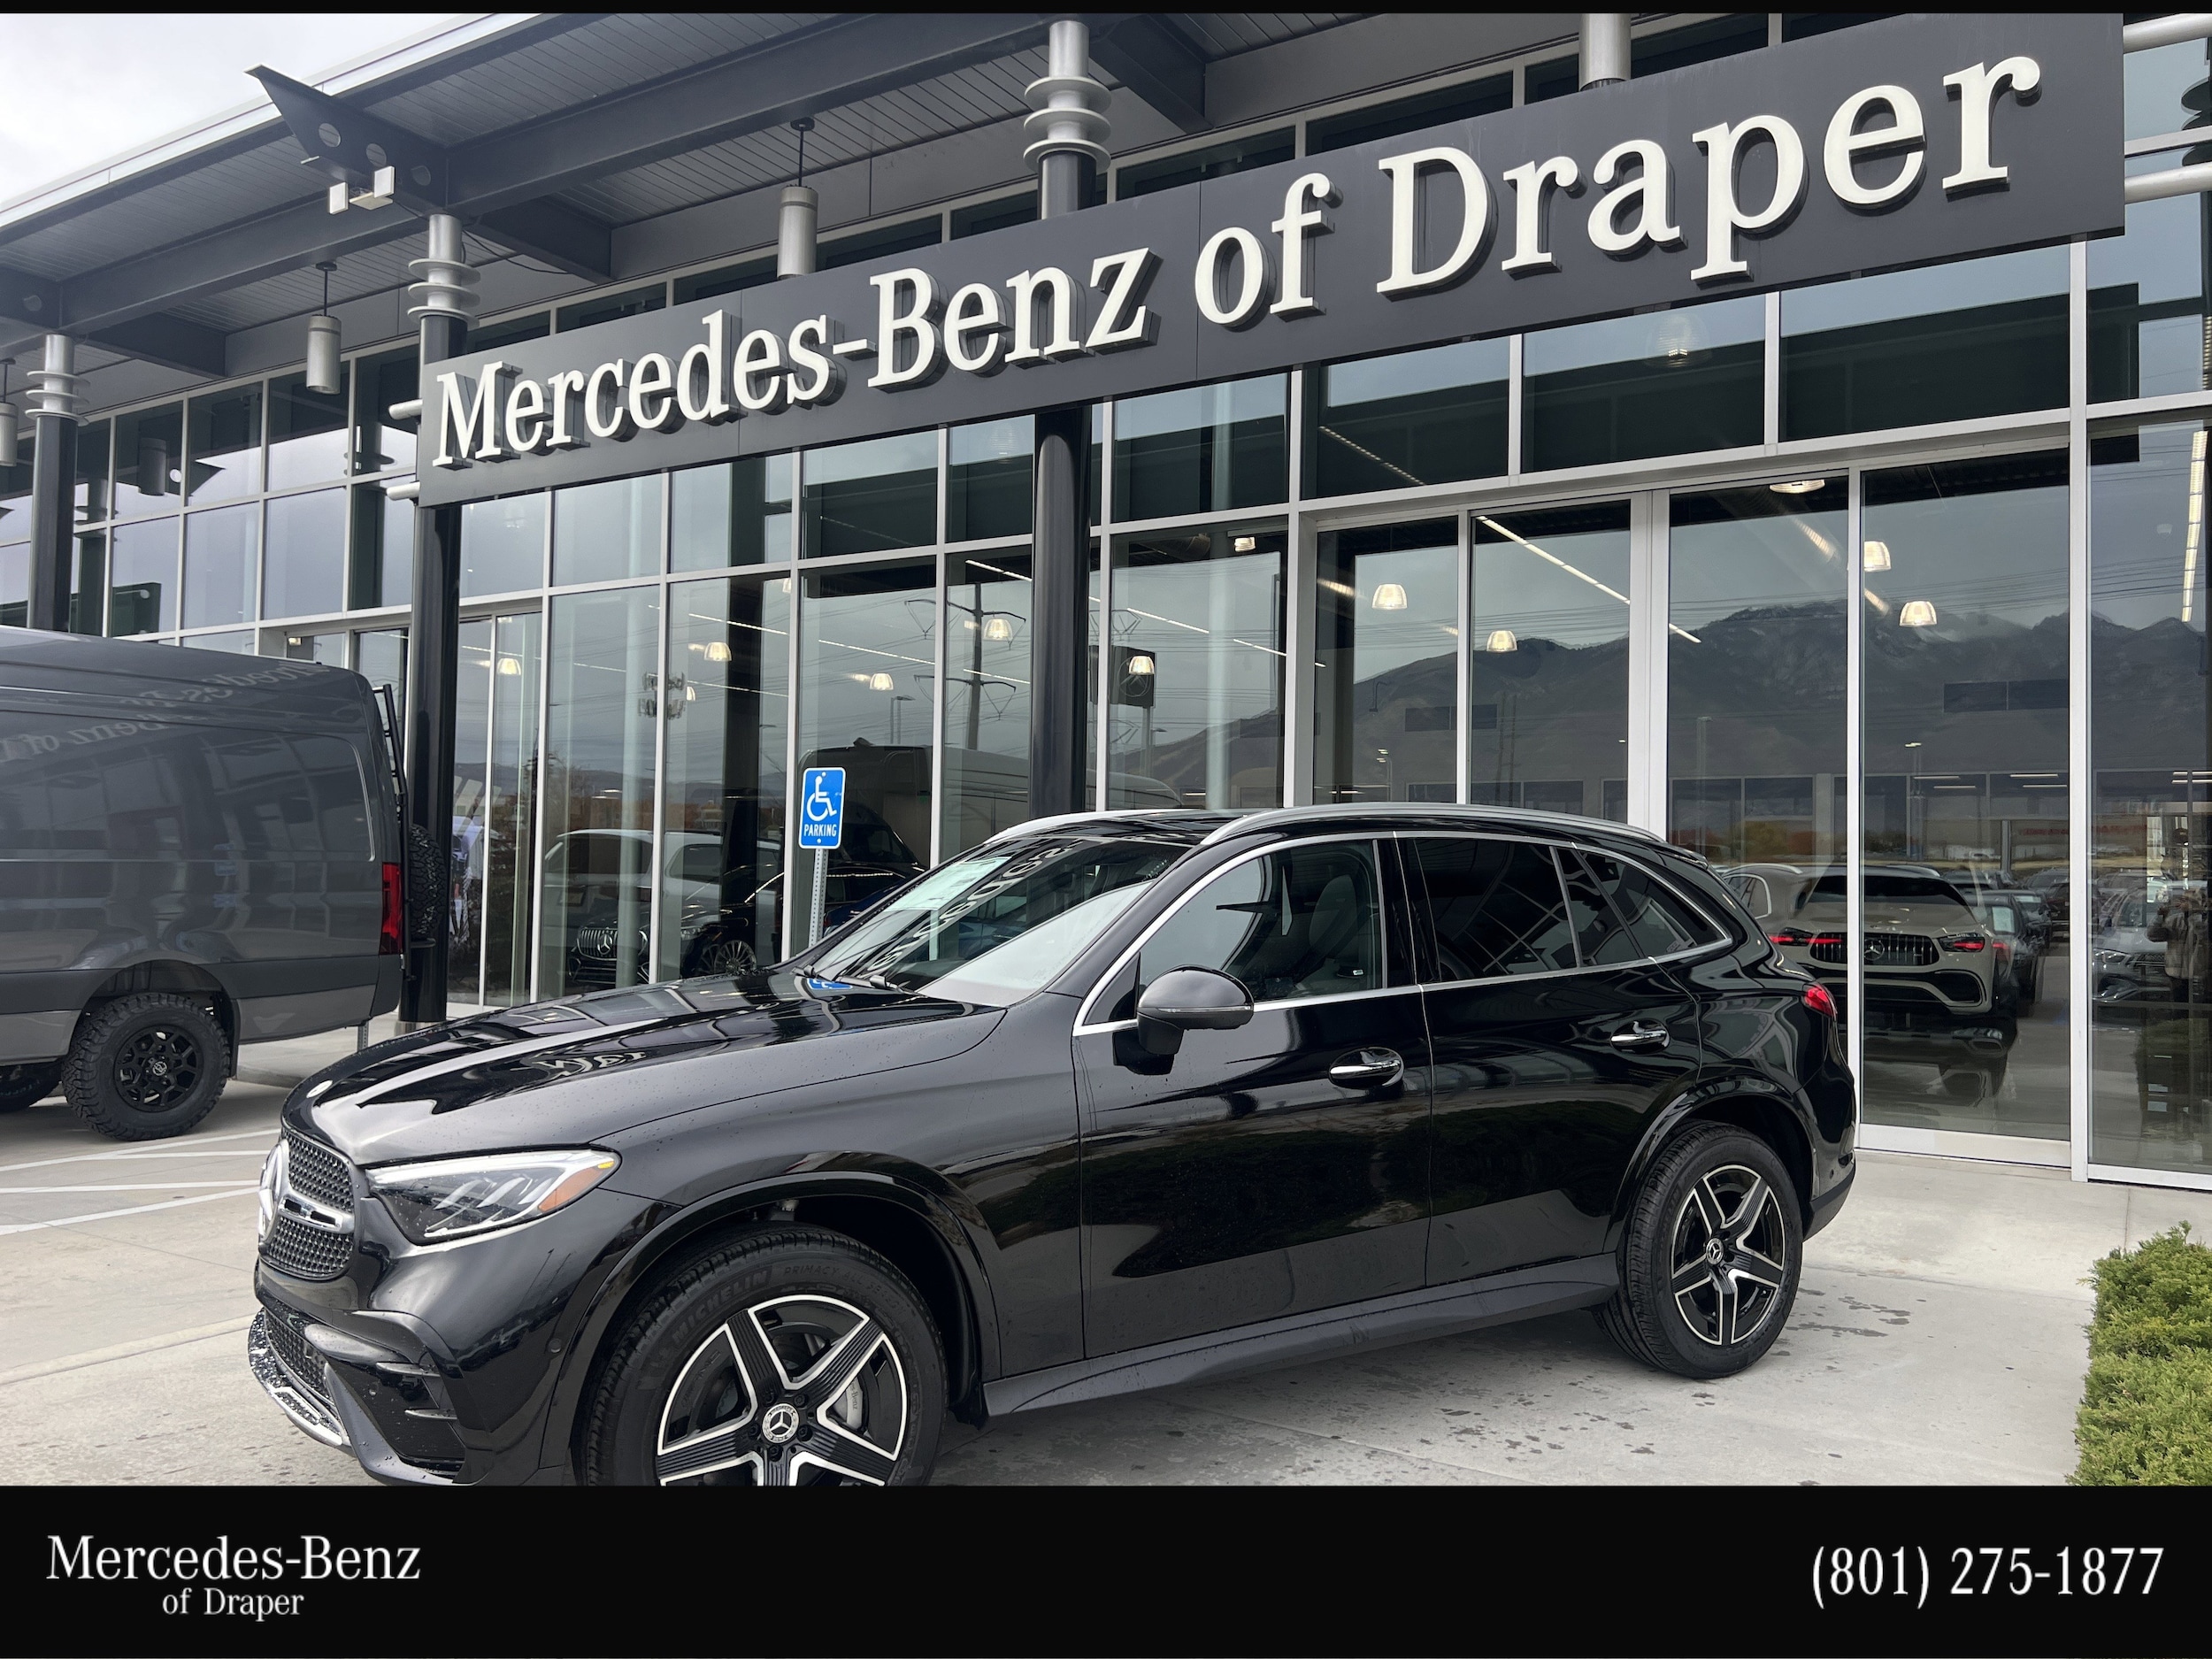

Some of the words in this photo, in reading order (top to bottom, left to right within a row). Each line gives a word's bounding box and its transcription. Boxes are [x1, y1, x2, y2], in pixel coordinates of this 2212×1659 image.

[433, 248, 1154, 466] Mercedes-Benz
[1194, 173, 1333, 326] of
[1376, 56, 2040, 296] Draper
[803, 824, 837, 837] PARKING
[672, 1270, 768, 1343] MICHELIN
